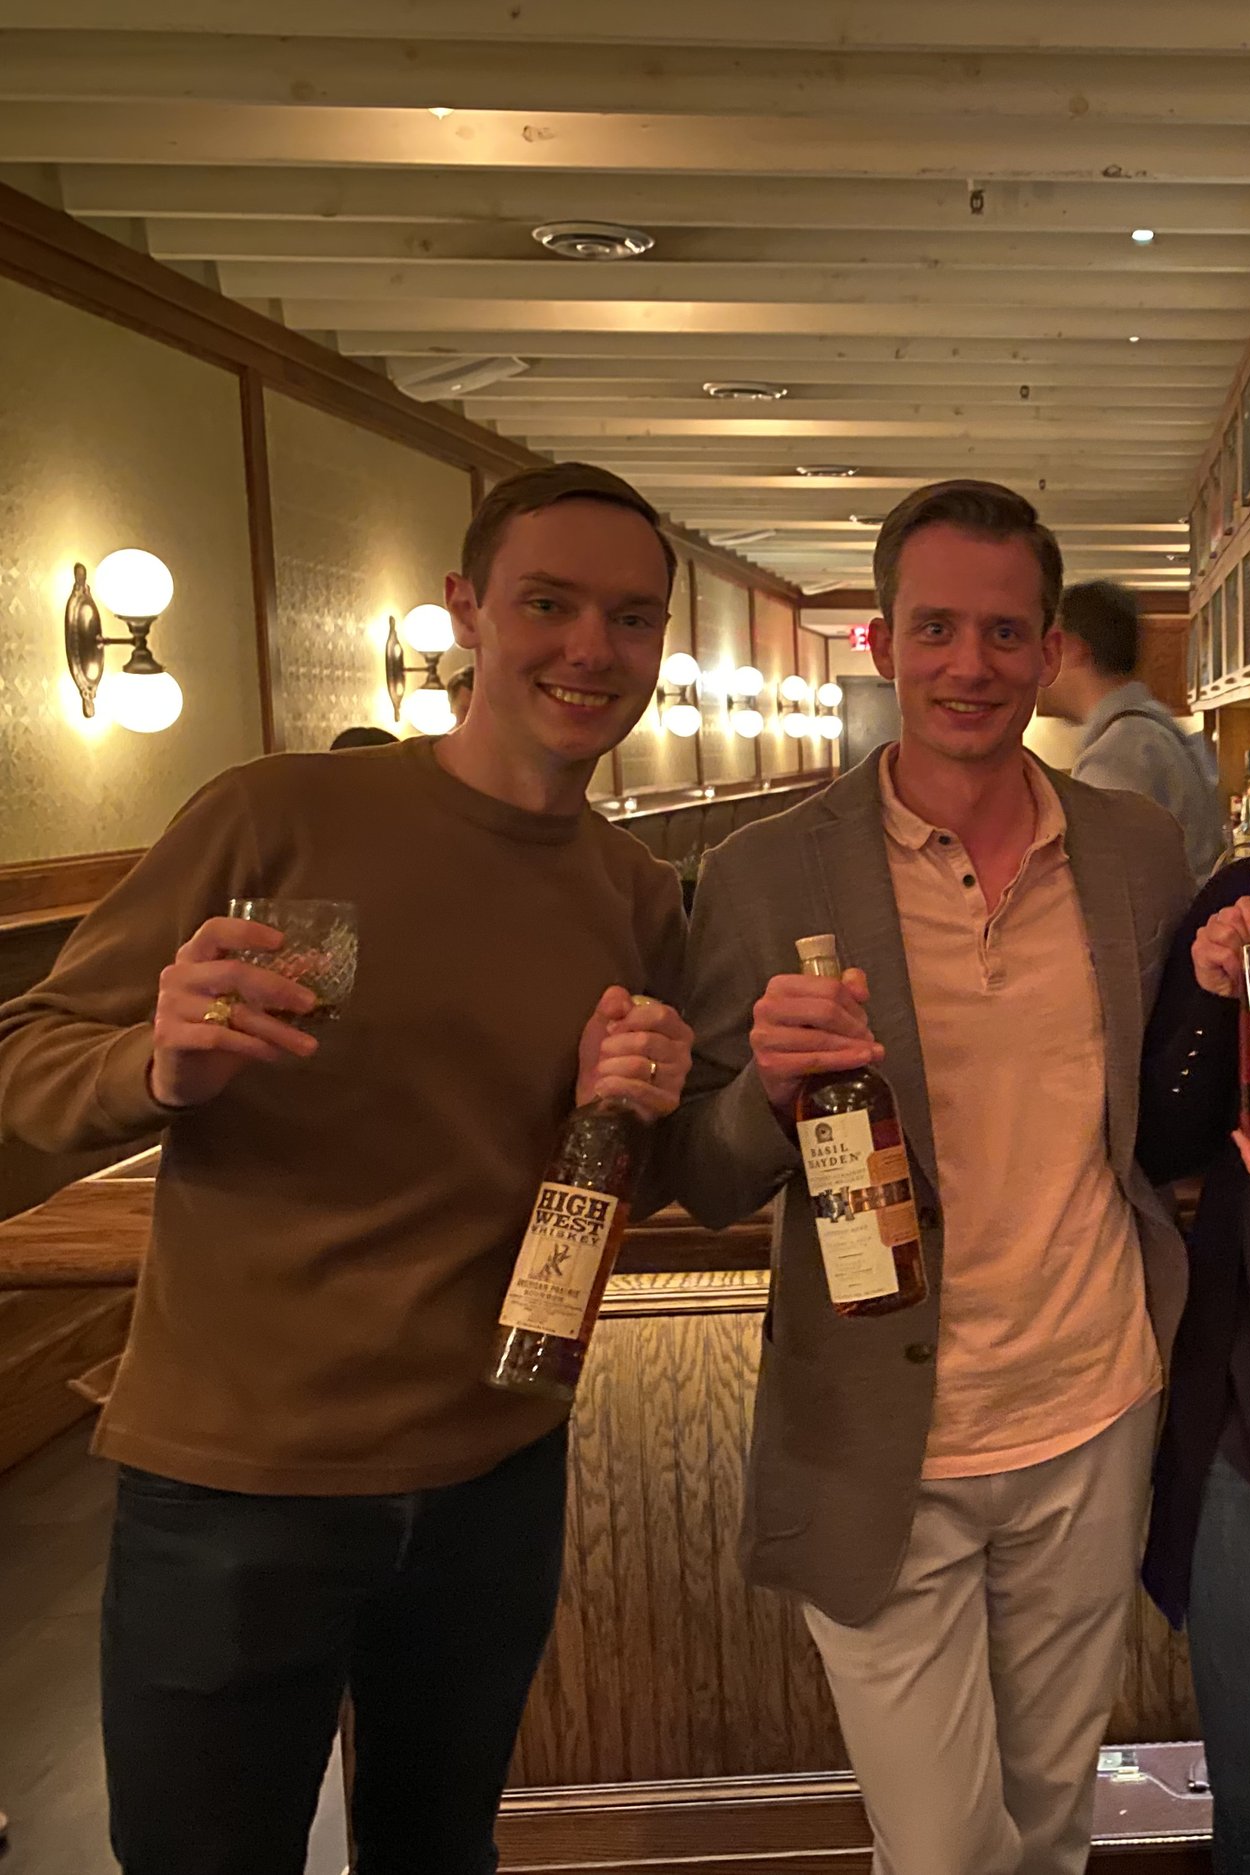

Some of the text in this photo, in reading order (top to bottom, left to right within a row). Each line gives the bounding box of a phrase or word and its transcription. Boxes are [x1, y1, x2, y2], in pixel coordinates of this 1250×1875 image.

[810, 1143, 849, 1158] BASIL
[537, 1188, 611, 1222] HIGH
[535, 1209, 604, 1236] WEST
[530, 1224, 601, 1247] WHISKEY
